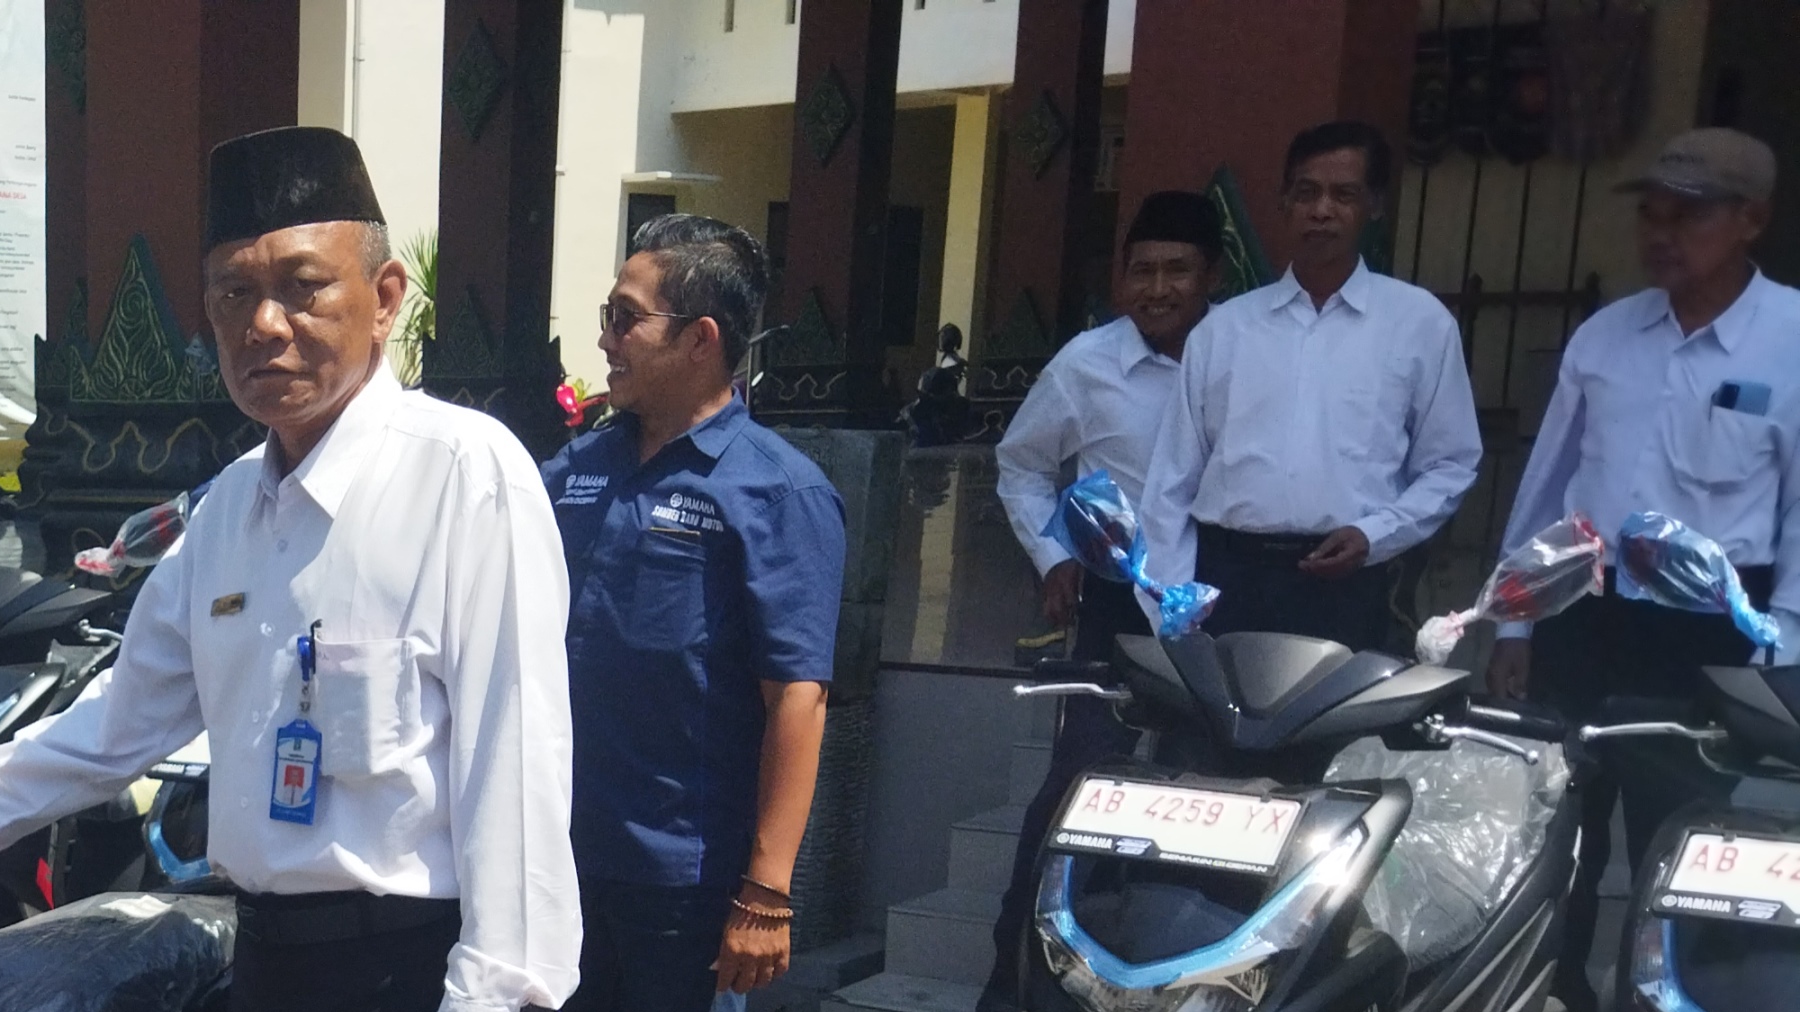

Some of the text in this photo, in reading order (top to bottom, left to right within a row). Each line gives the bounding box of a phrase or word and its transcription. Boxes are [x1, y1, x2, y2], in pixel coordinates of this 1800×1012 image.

[682, 496, 715, 516] YAMAHA
[1083, 788, 1288, 834] AB 4259 YX
[1068, 834, 1113, 849] YAMAHA
[1689, 844, 1739, 872] AB
[1677, 896, 1731, 913] YAMAHA
